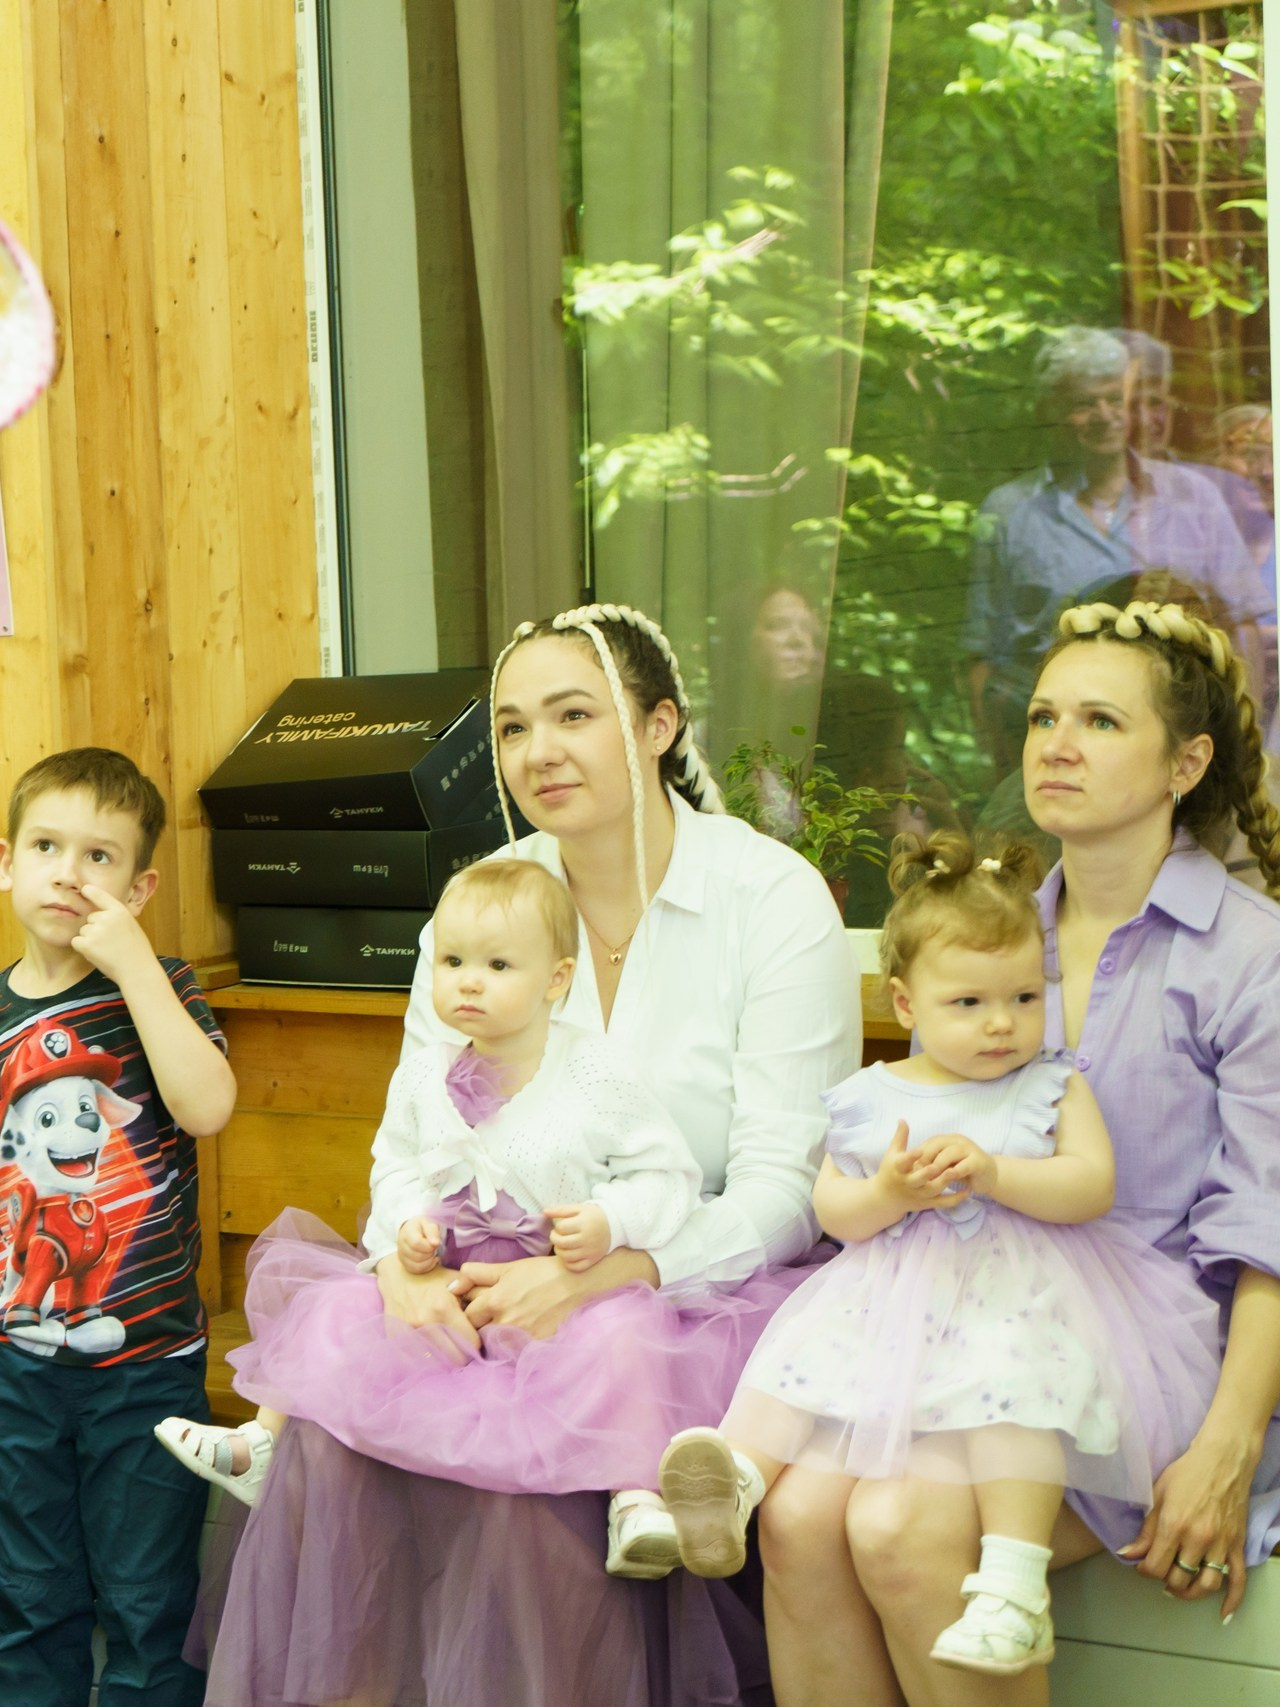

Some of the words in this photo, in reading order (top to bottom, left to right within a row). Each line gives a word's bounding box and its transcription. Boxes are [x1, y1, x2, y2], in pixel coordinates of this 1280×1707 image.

[276, 711, 357, 728] catering
[254, 719, 433, 745] TANUKIFAMILY
[344, 806, 384, 816] ТАНУКИ
[248, 863, 286, 871] ТАНУКИ
[375, 947, 416, 956] ТАНУКИ
